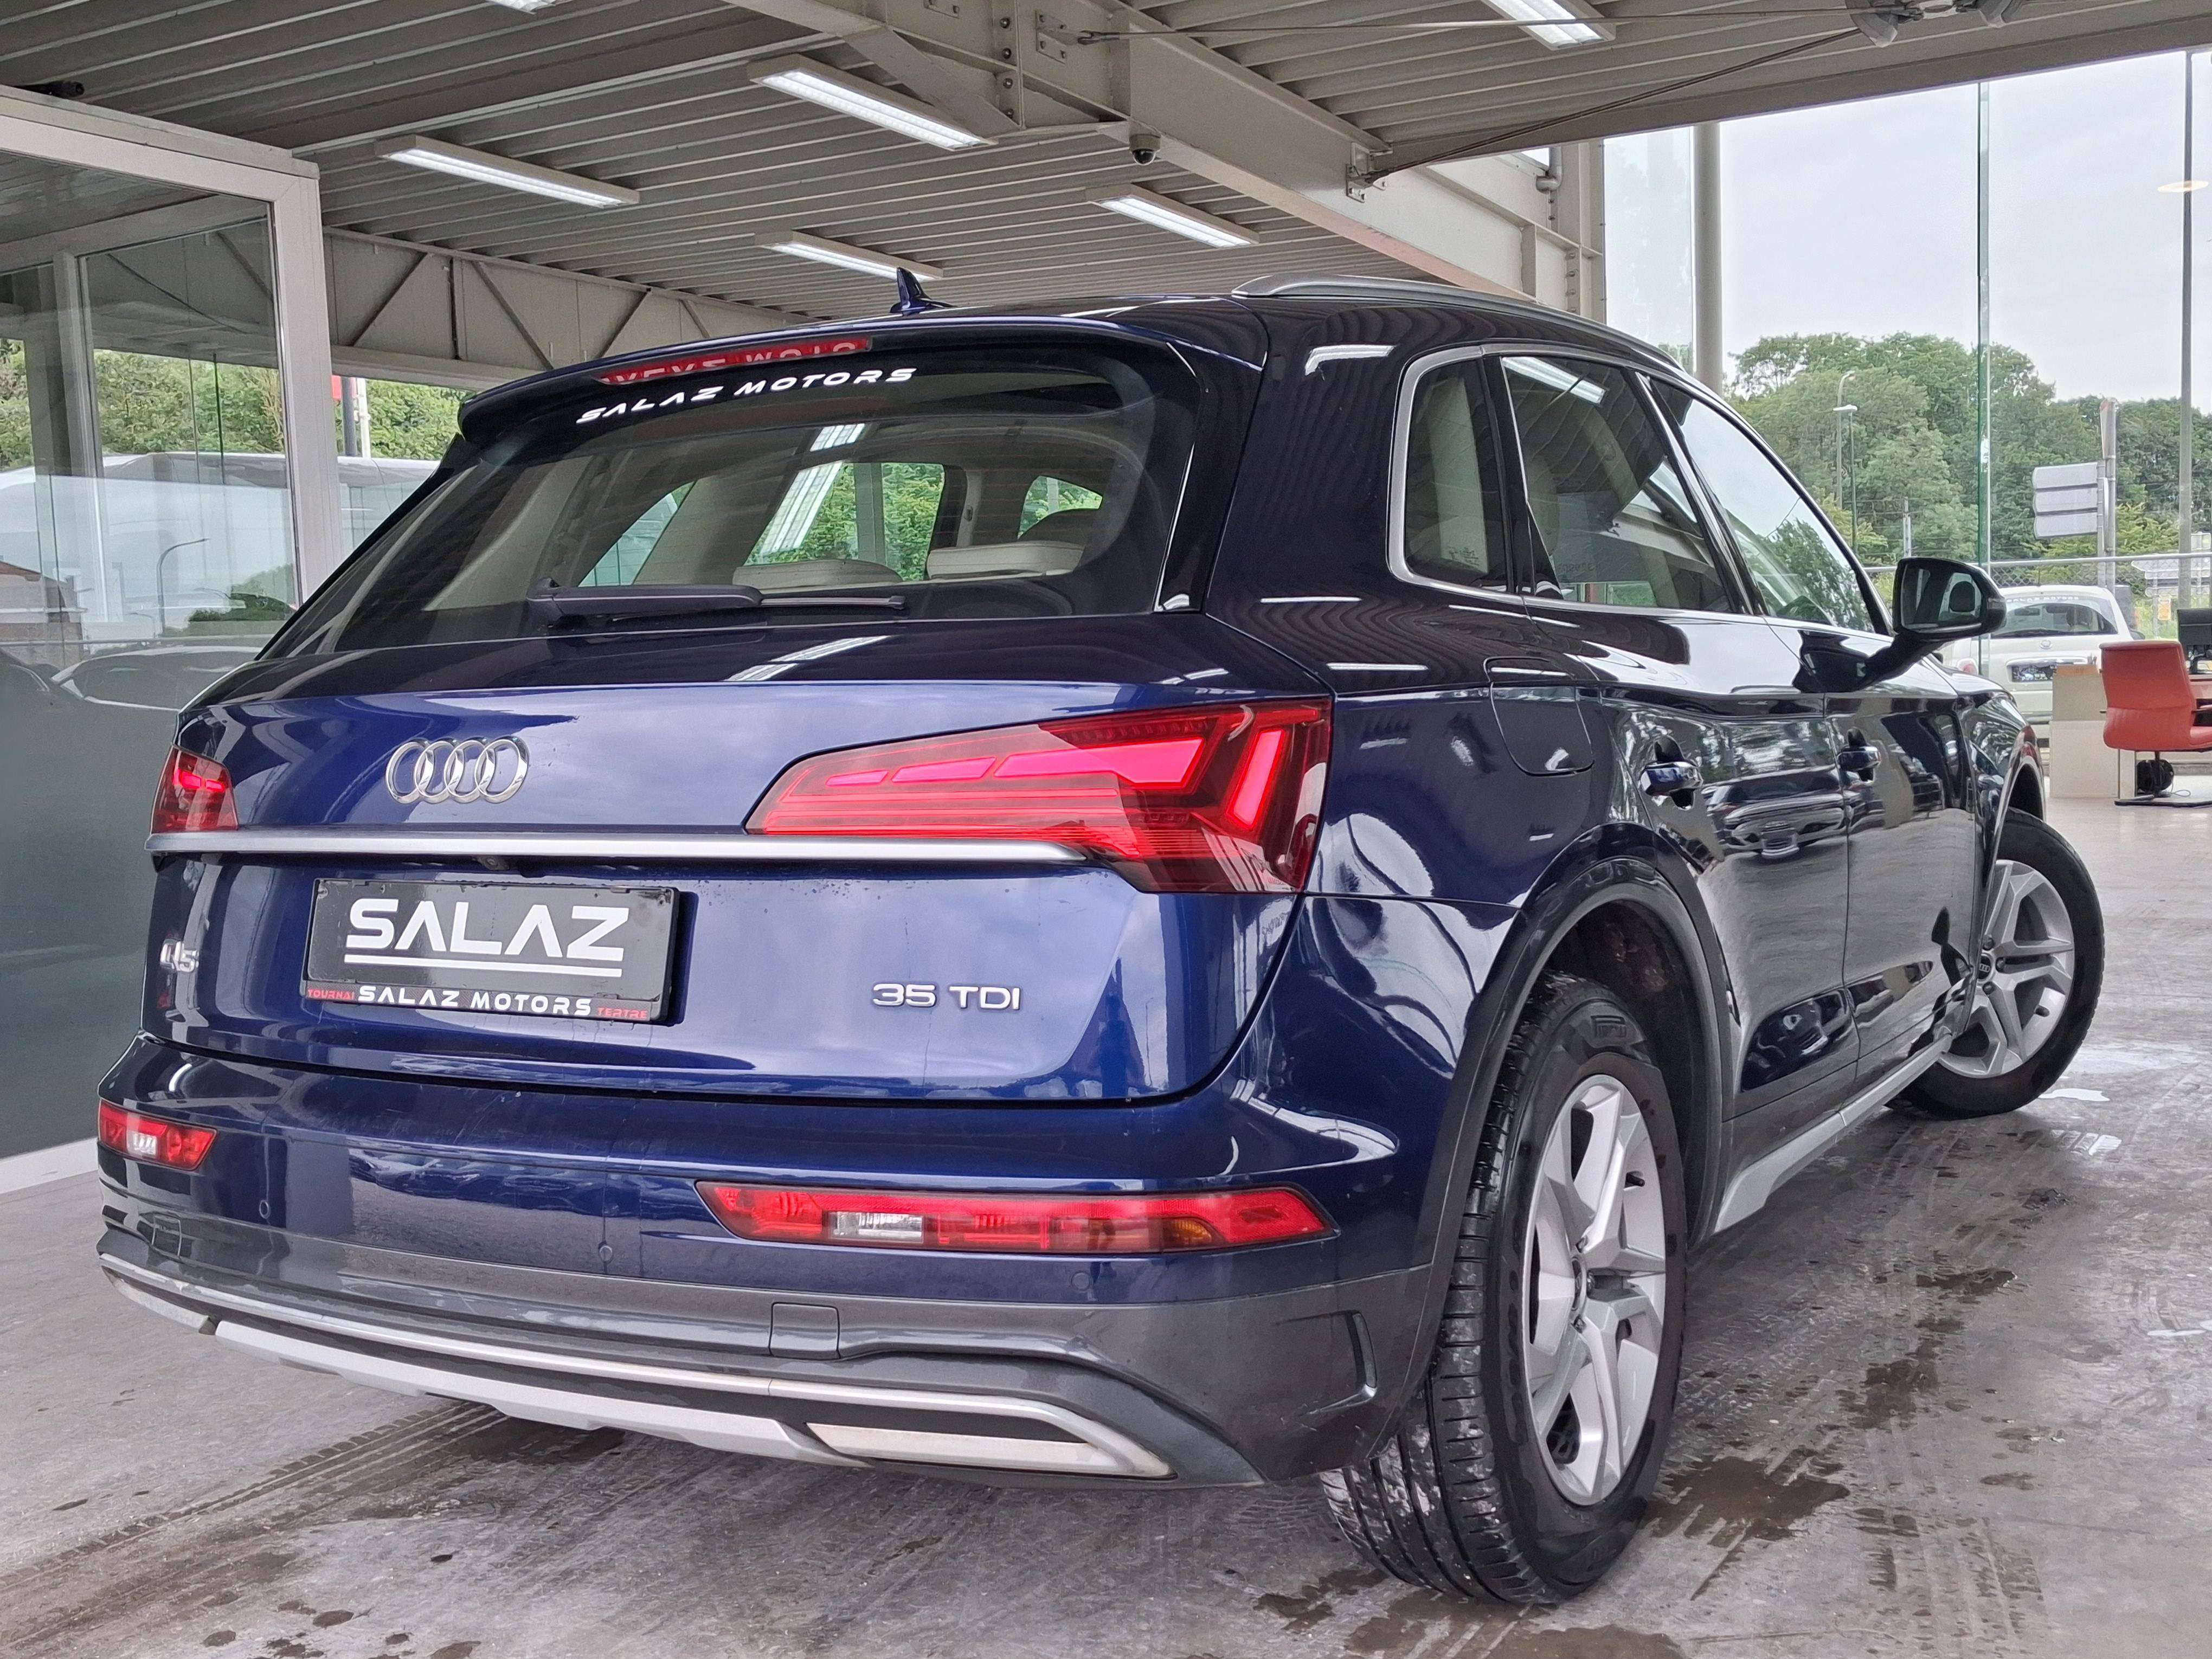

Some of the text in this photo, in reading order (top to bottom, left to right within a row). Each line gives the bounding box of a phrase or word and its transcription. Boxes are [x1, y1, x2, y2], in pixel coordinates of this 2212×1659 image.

[576, 385, 724, 424] SALAZ
[734, 367, 917, 397] MOTORS
[345, 898, 629, 962] SALAZ
[307, 985, 648, 1019] TOURNAI SALAZ MOTORS TERTRE
[872, 983, 1020, 1010] 35 TDI
